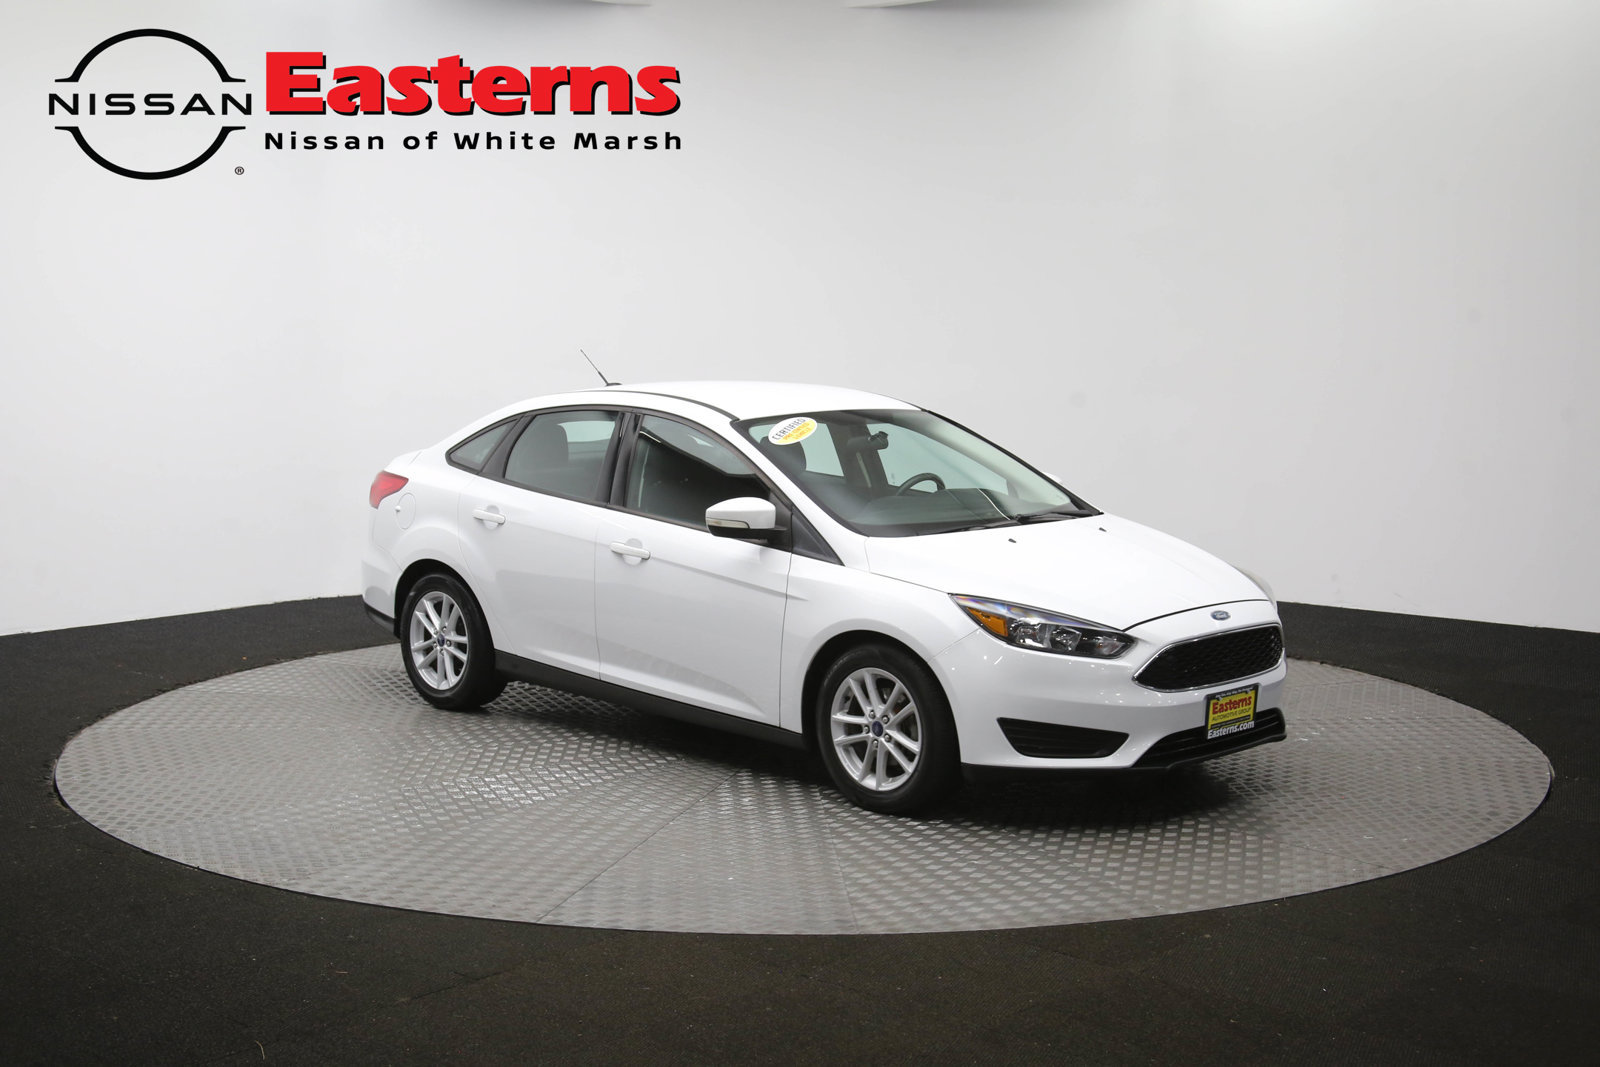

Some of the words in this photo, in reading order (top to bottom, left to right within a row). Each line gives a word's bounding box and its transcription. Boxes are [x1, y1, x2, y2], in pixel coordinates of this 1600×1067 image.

[772, 418, 806, 440] CERTIFIED
[1212, 696, 1252, 715] Easterns
[1207, 721, 1255, 740] Easterns.com
